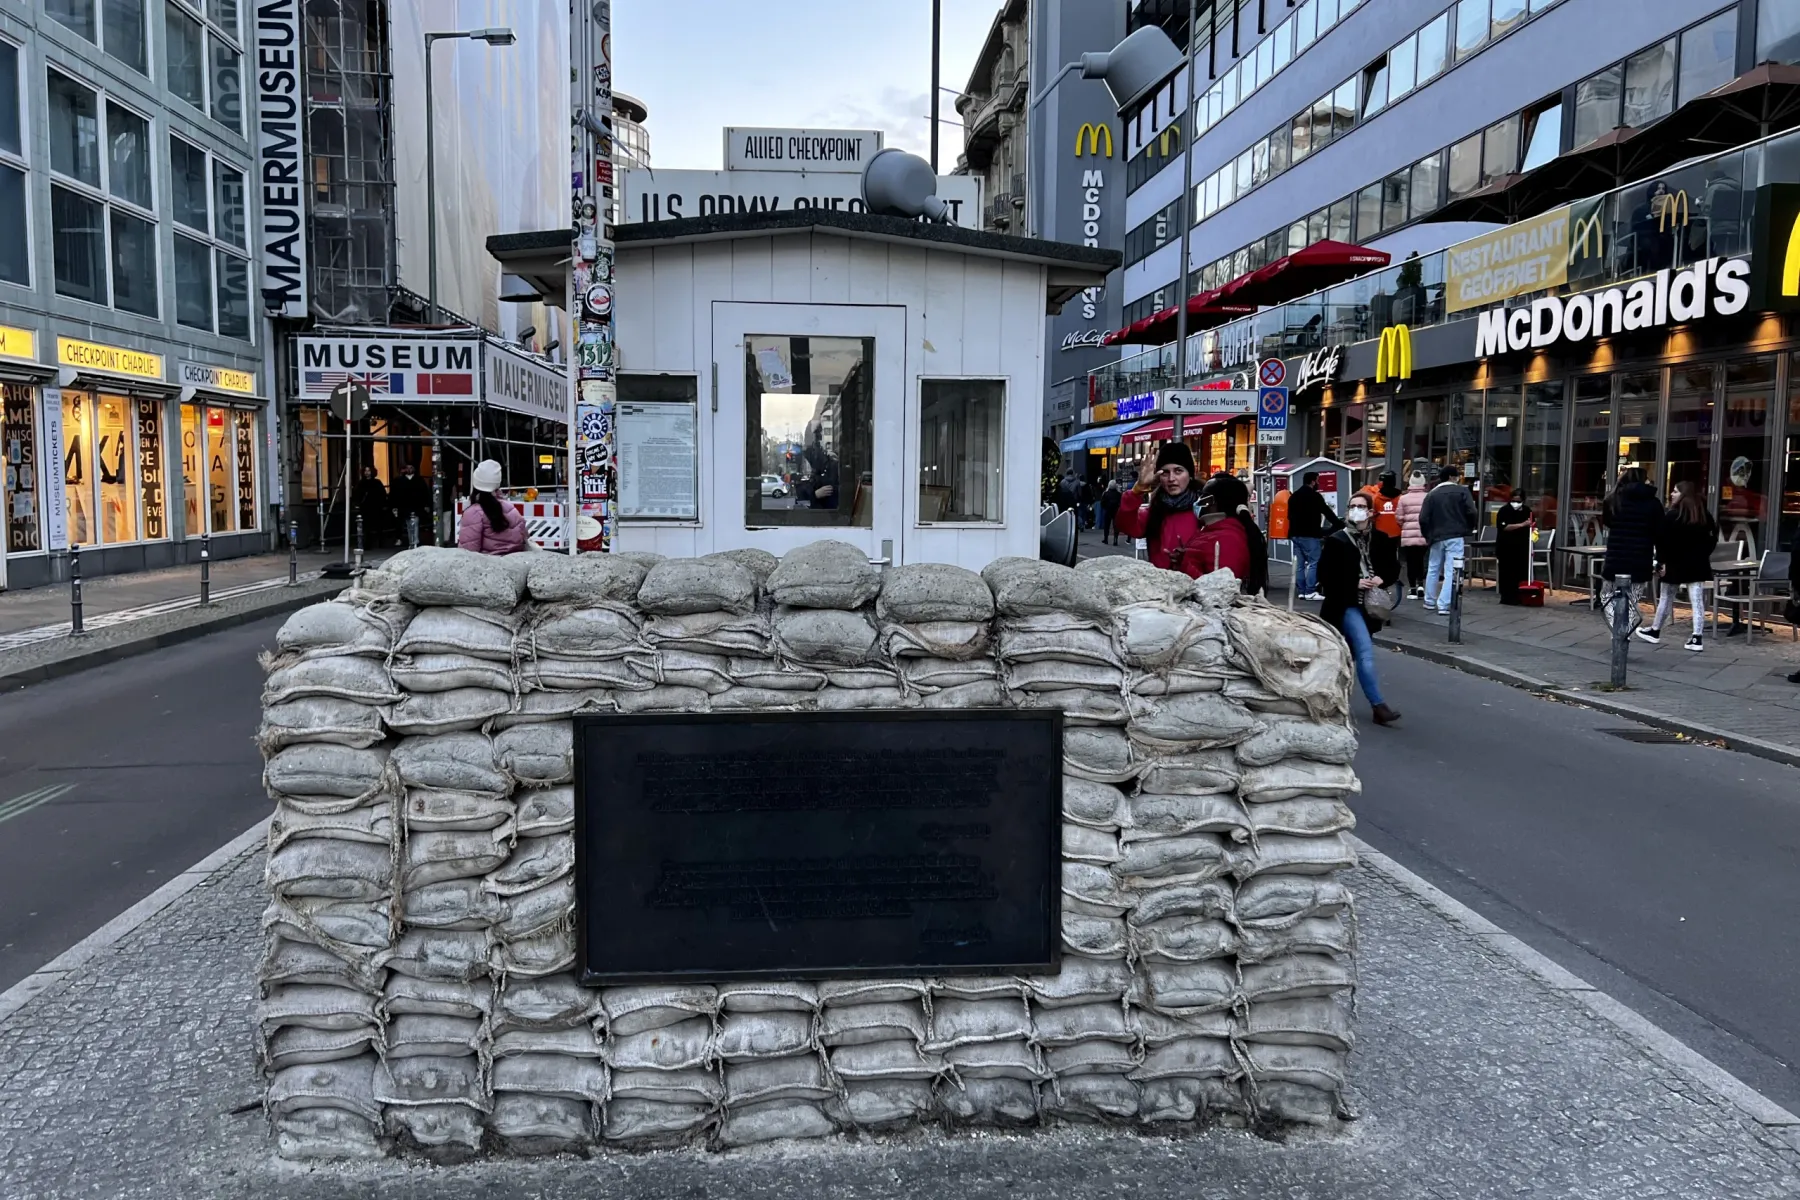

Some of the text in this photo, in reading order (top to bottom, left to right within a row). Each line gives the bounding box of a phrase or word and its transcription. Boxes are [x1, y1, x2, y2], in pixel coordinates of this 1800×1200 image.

[745, 136, 863, 161] ALLIED CHECKPOINT
[1451, 217, 1566, 278] RESTAURANT
[1460, 256, 1549, 301] GEÖFFNET
[1475, 256, 1750, 357] McDonald's
[1062, 329, 1111, 348] McCaf
[1222, 317, 1260, 369] COFFEE
[67, 344, 154, 375] CHECKPOINT CHARLIE
[304, 344, 472, 369] MUSEUM
[579, 344, 613, 366] 1312
[1297, 345, 1339, 389] McCafé
[185, 366, 248, 390] CHECKPOINT CHARLIE
[1185, 397, 1248, 406] Jüdisches Museum
[1261, 416, 1284, 426] TAXI
[51, 420, 61, 517] MUSEUMTICKETS
